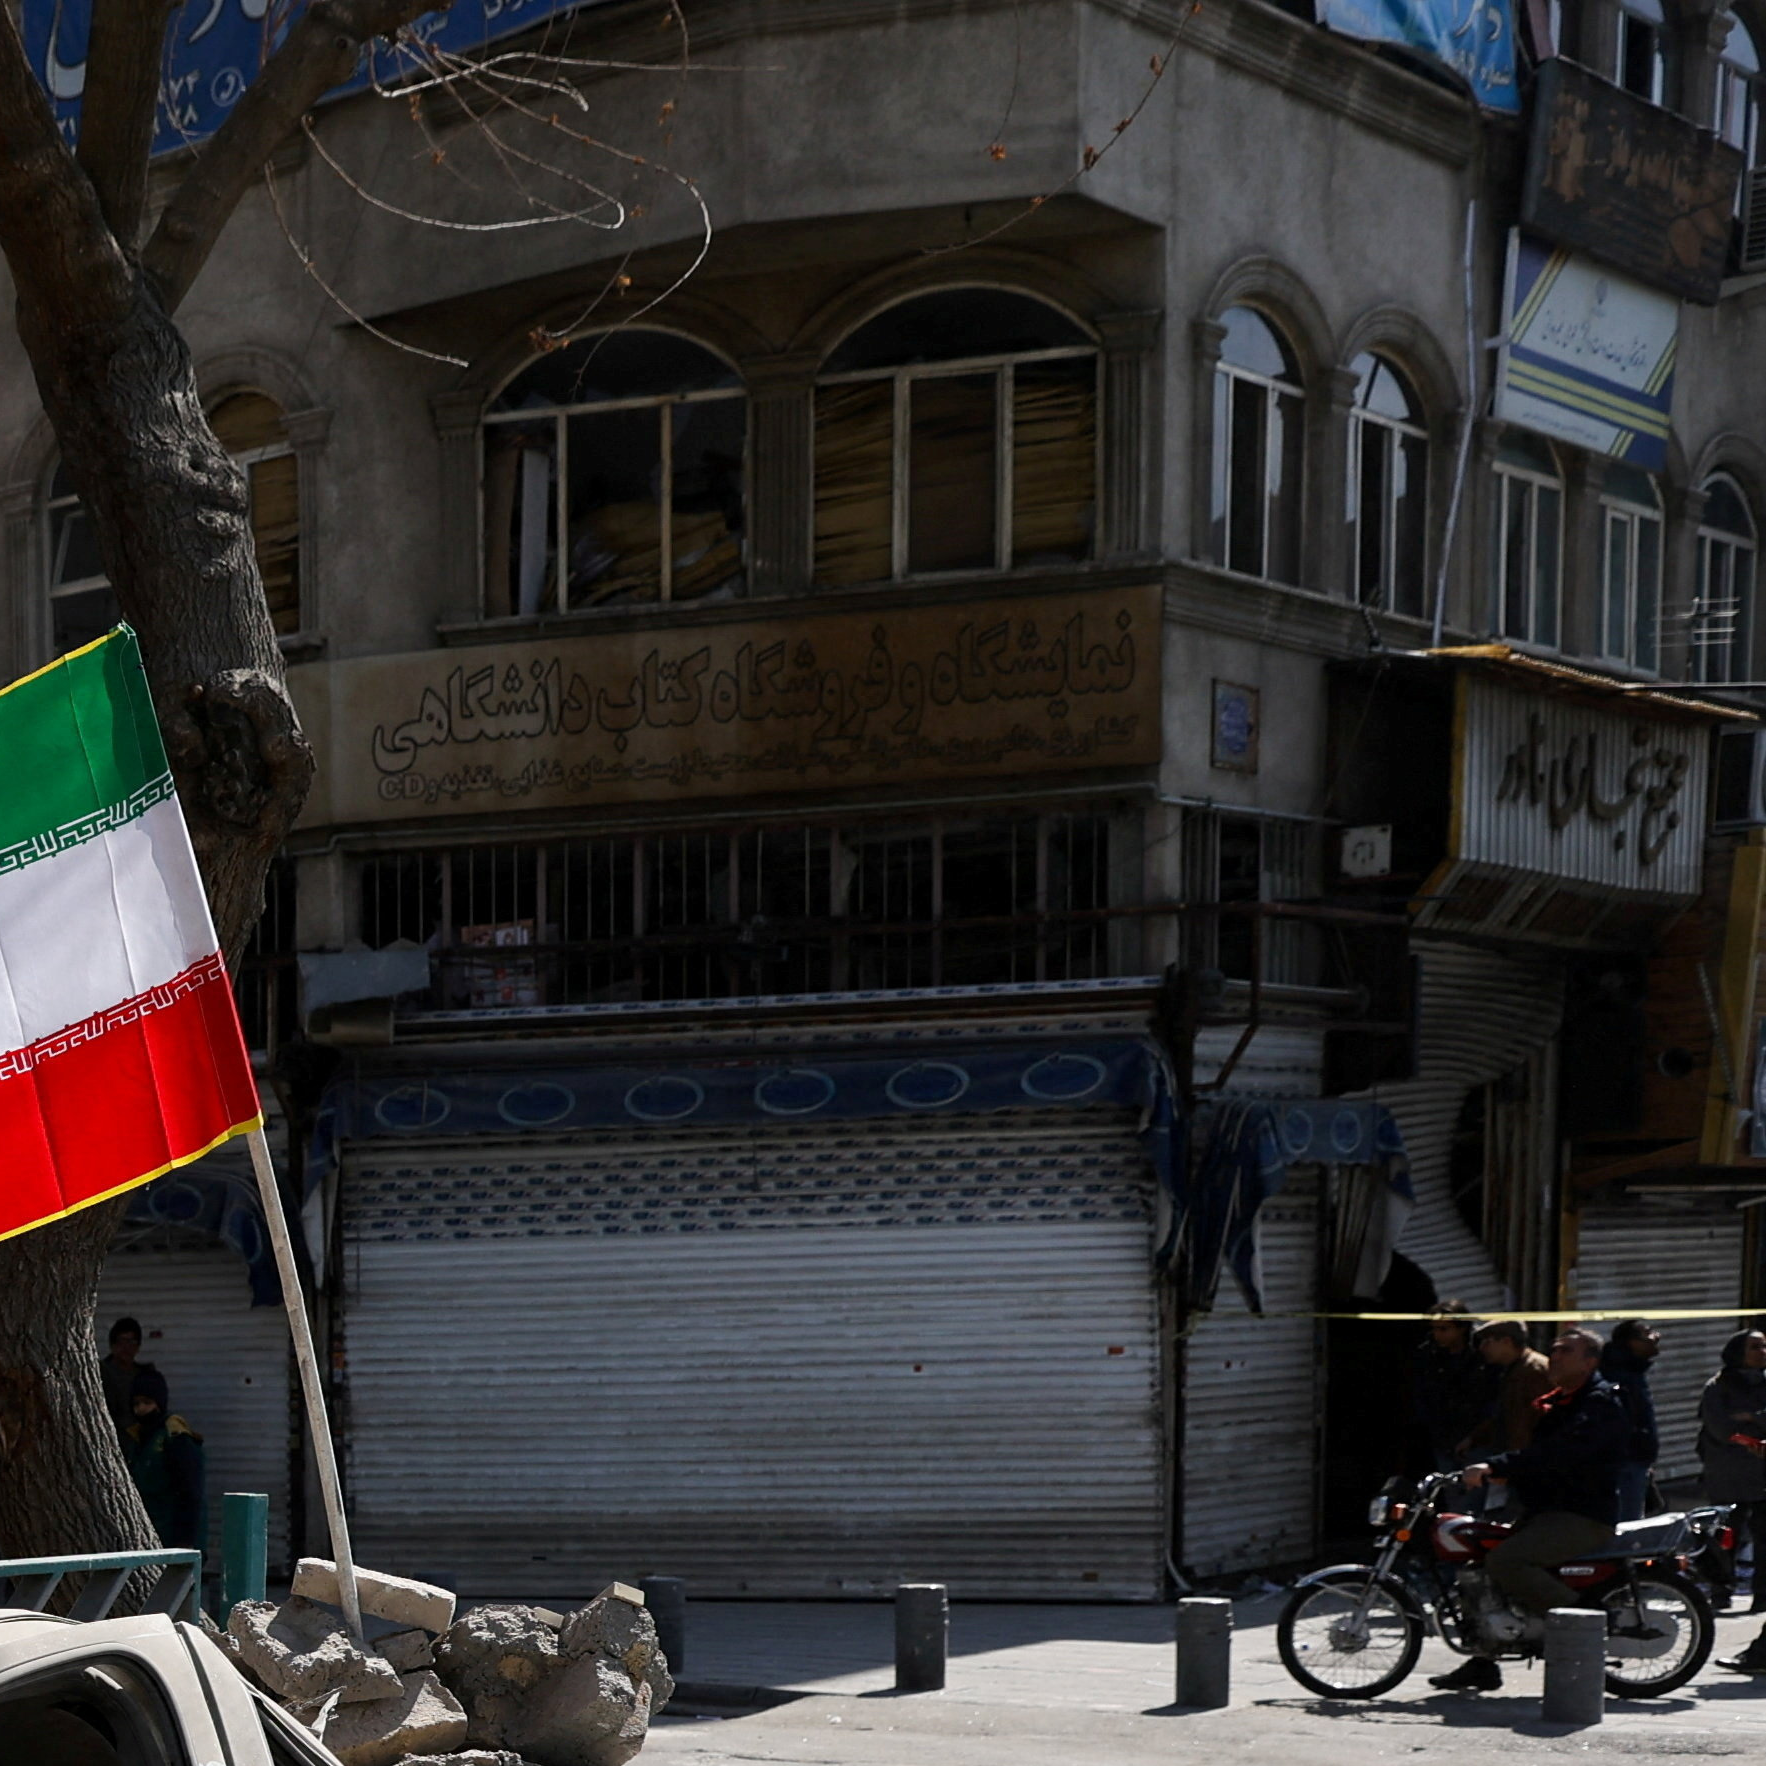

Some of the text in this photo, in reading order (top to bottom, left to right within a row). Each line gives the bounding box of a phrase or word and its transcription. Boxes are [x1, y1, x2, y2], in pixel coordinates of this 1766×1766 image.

[372, 656, 593, 774] دانشگاهی
[596, 645, 712, 754] کتاب
[710, 624, 892, 741] فروشگاه
[891, 661, 925, 736] و
[930, 608, 1137, 720] نمایشگاه
[378, 772, 426, 801] CD
